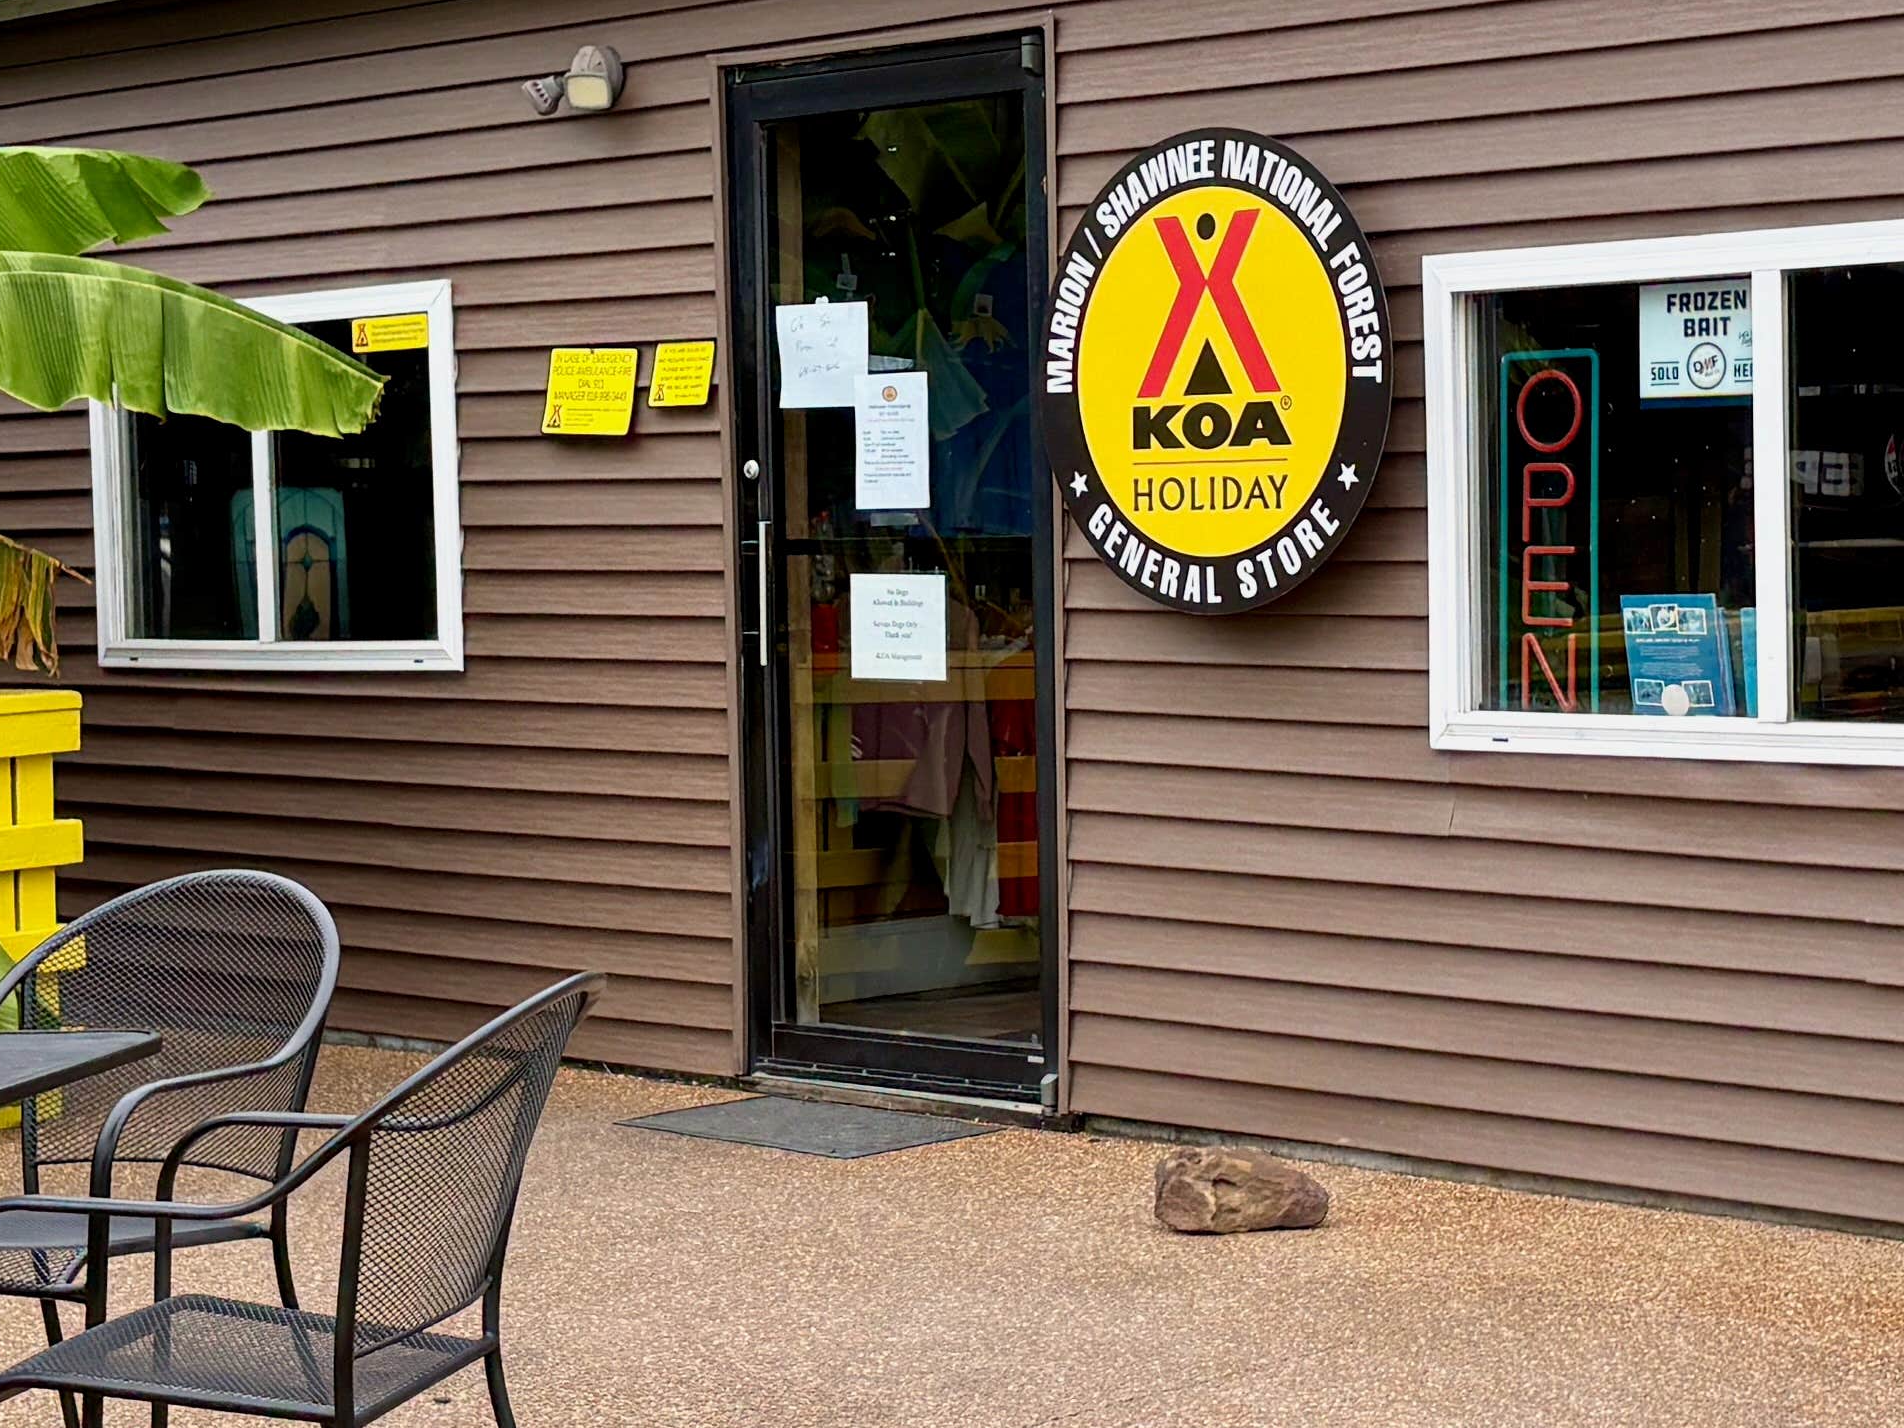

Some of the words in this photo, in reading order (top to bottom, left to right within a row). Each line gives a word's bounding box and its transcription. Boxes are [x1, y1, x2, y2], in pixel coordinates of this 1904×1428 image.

[1046, 251, 1096, 394] MARION
[1096, 139, 1216, 239] SHAWNEE
[1222, 139, 1344, 252] NATIONAL
[1330, 241, 1383, 384] FOREST
[1666, 289, 1747, 314] FROZEN
[1683, 316, 1731, 338] BAIT
[1132, 401, 1292, 450] KOA
[1132, 474, 1289, 512] HOLIDAY
[1087, 502, 1223, 604] GENERAL
[1236, 499, 1340, 599] STORE
[1516, 369, 1583, 712] OPEN
